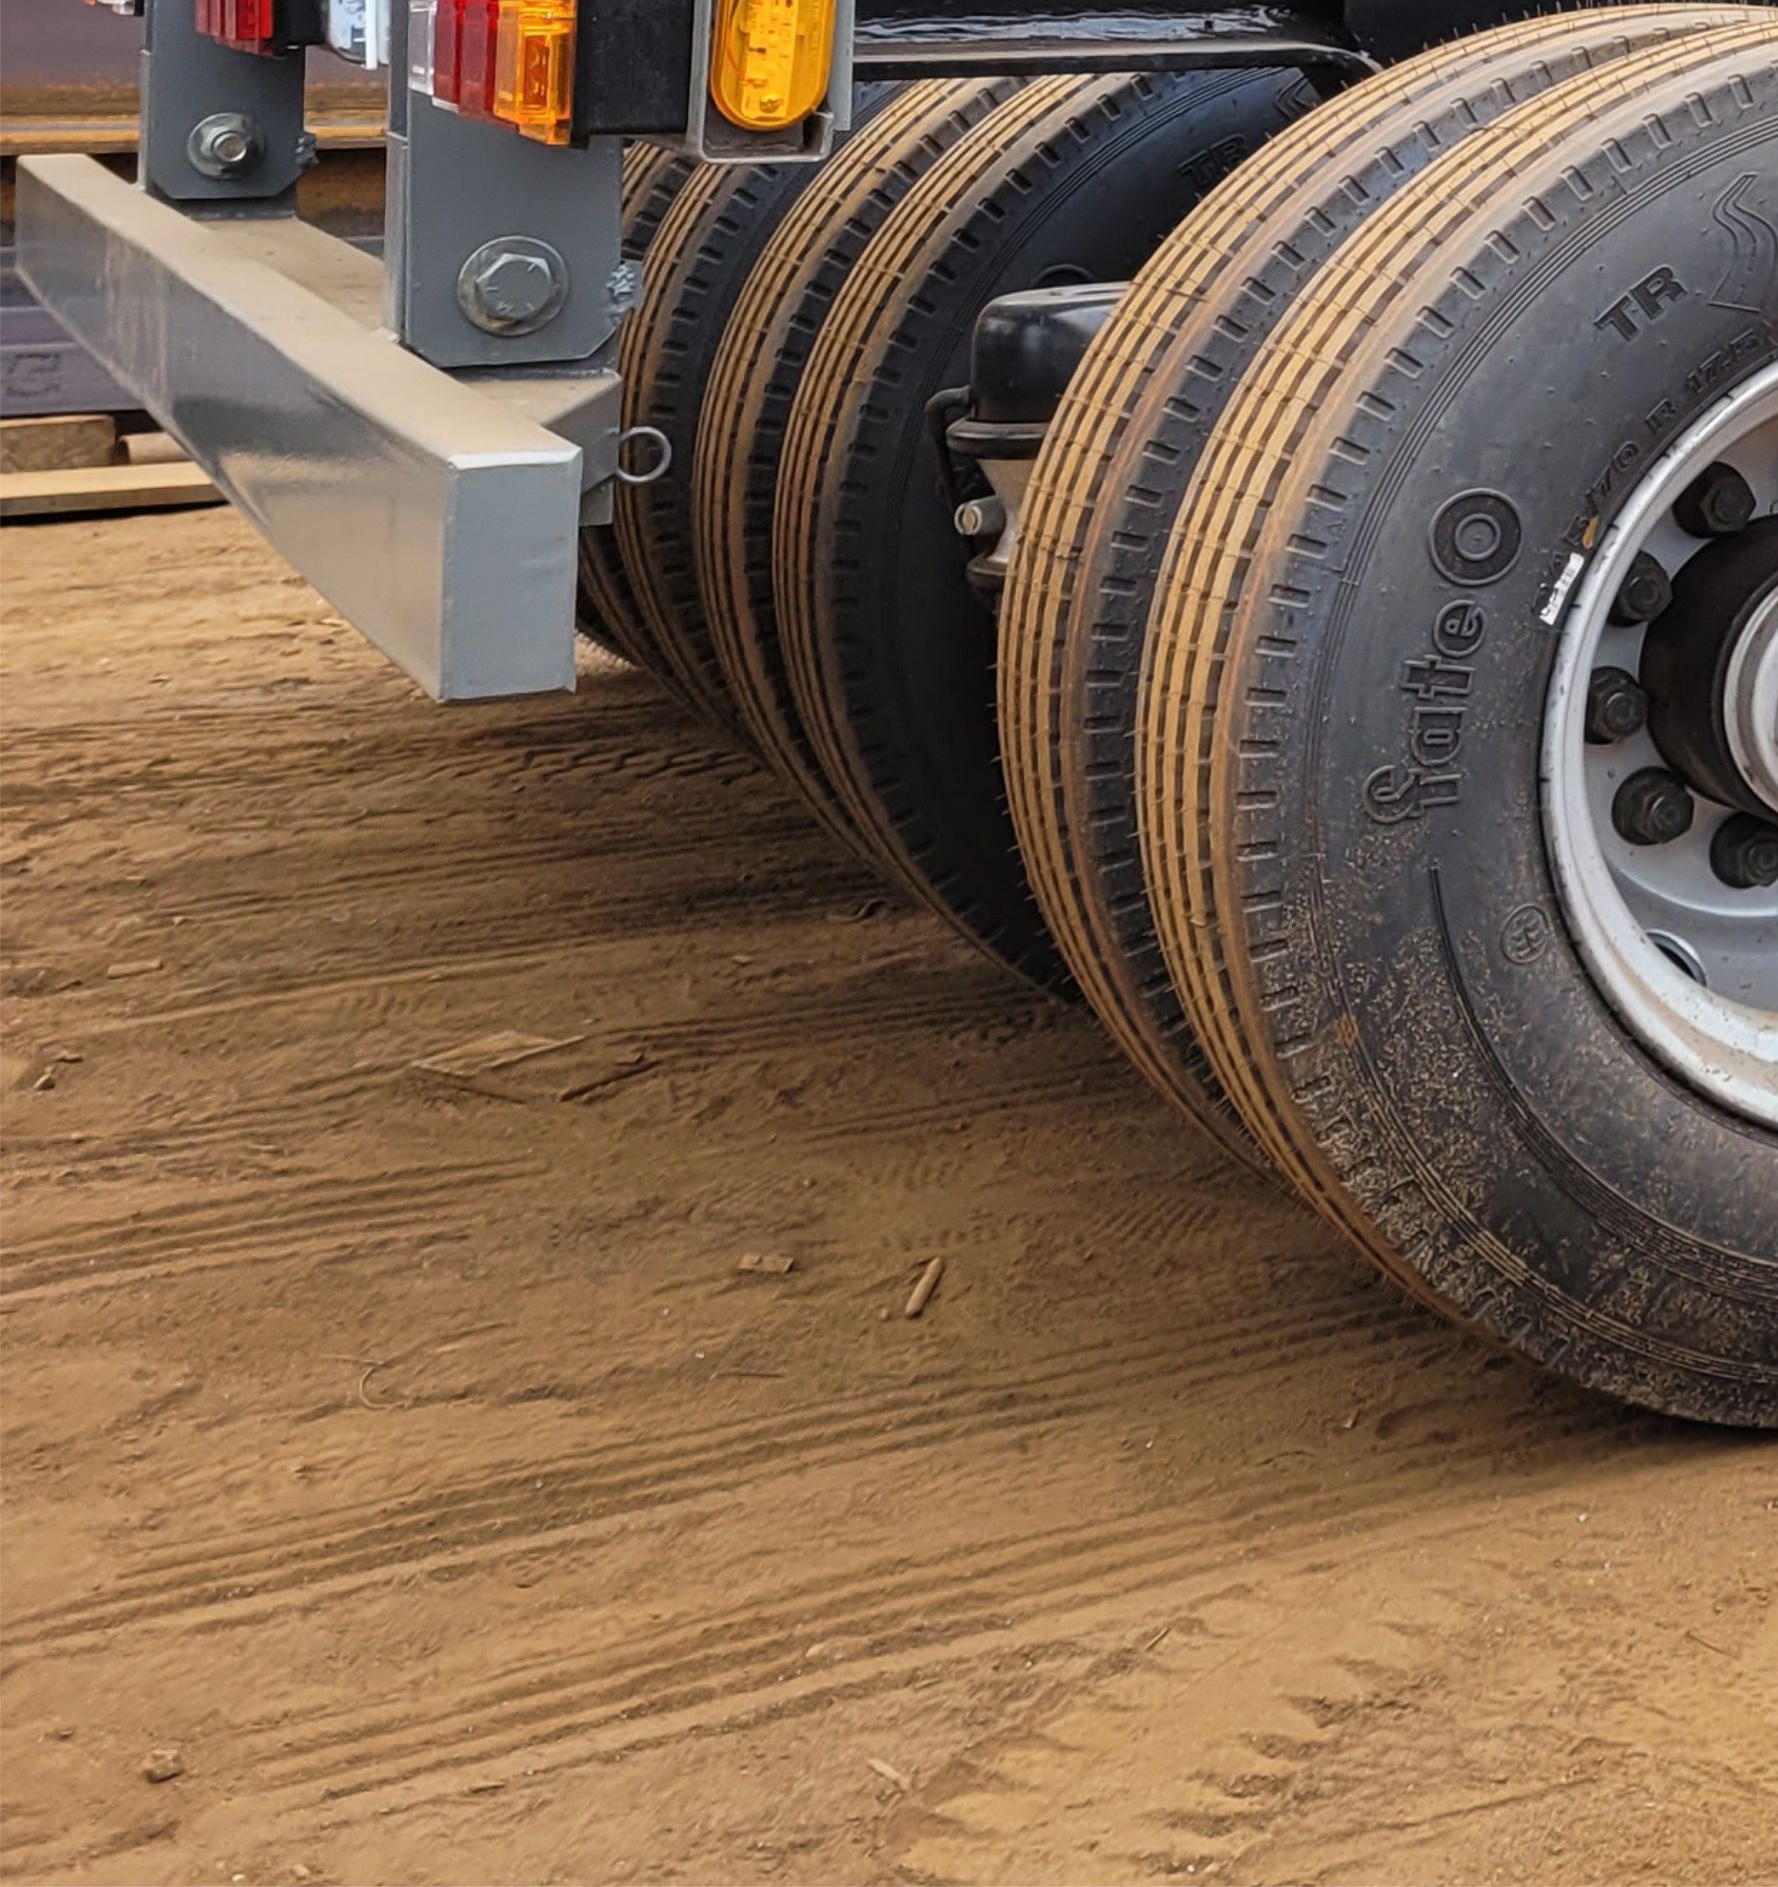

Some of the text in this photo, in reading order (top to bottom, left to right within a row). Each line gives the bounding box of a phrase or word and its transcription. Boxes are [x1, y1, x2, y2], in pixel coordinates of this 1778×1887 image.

[1593, 264, 1689, 343] TR
[1644, 398, 1678, 435] R
[1685, 328, 1764, 395] 17.5
